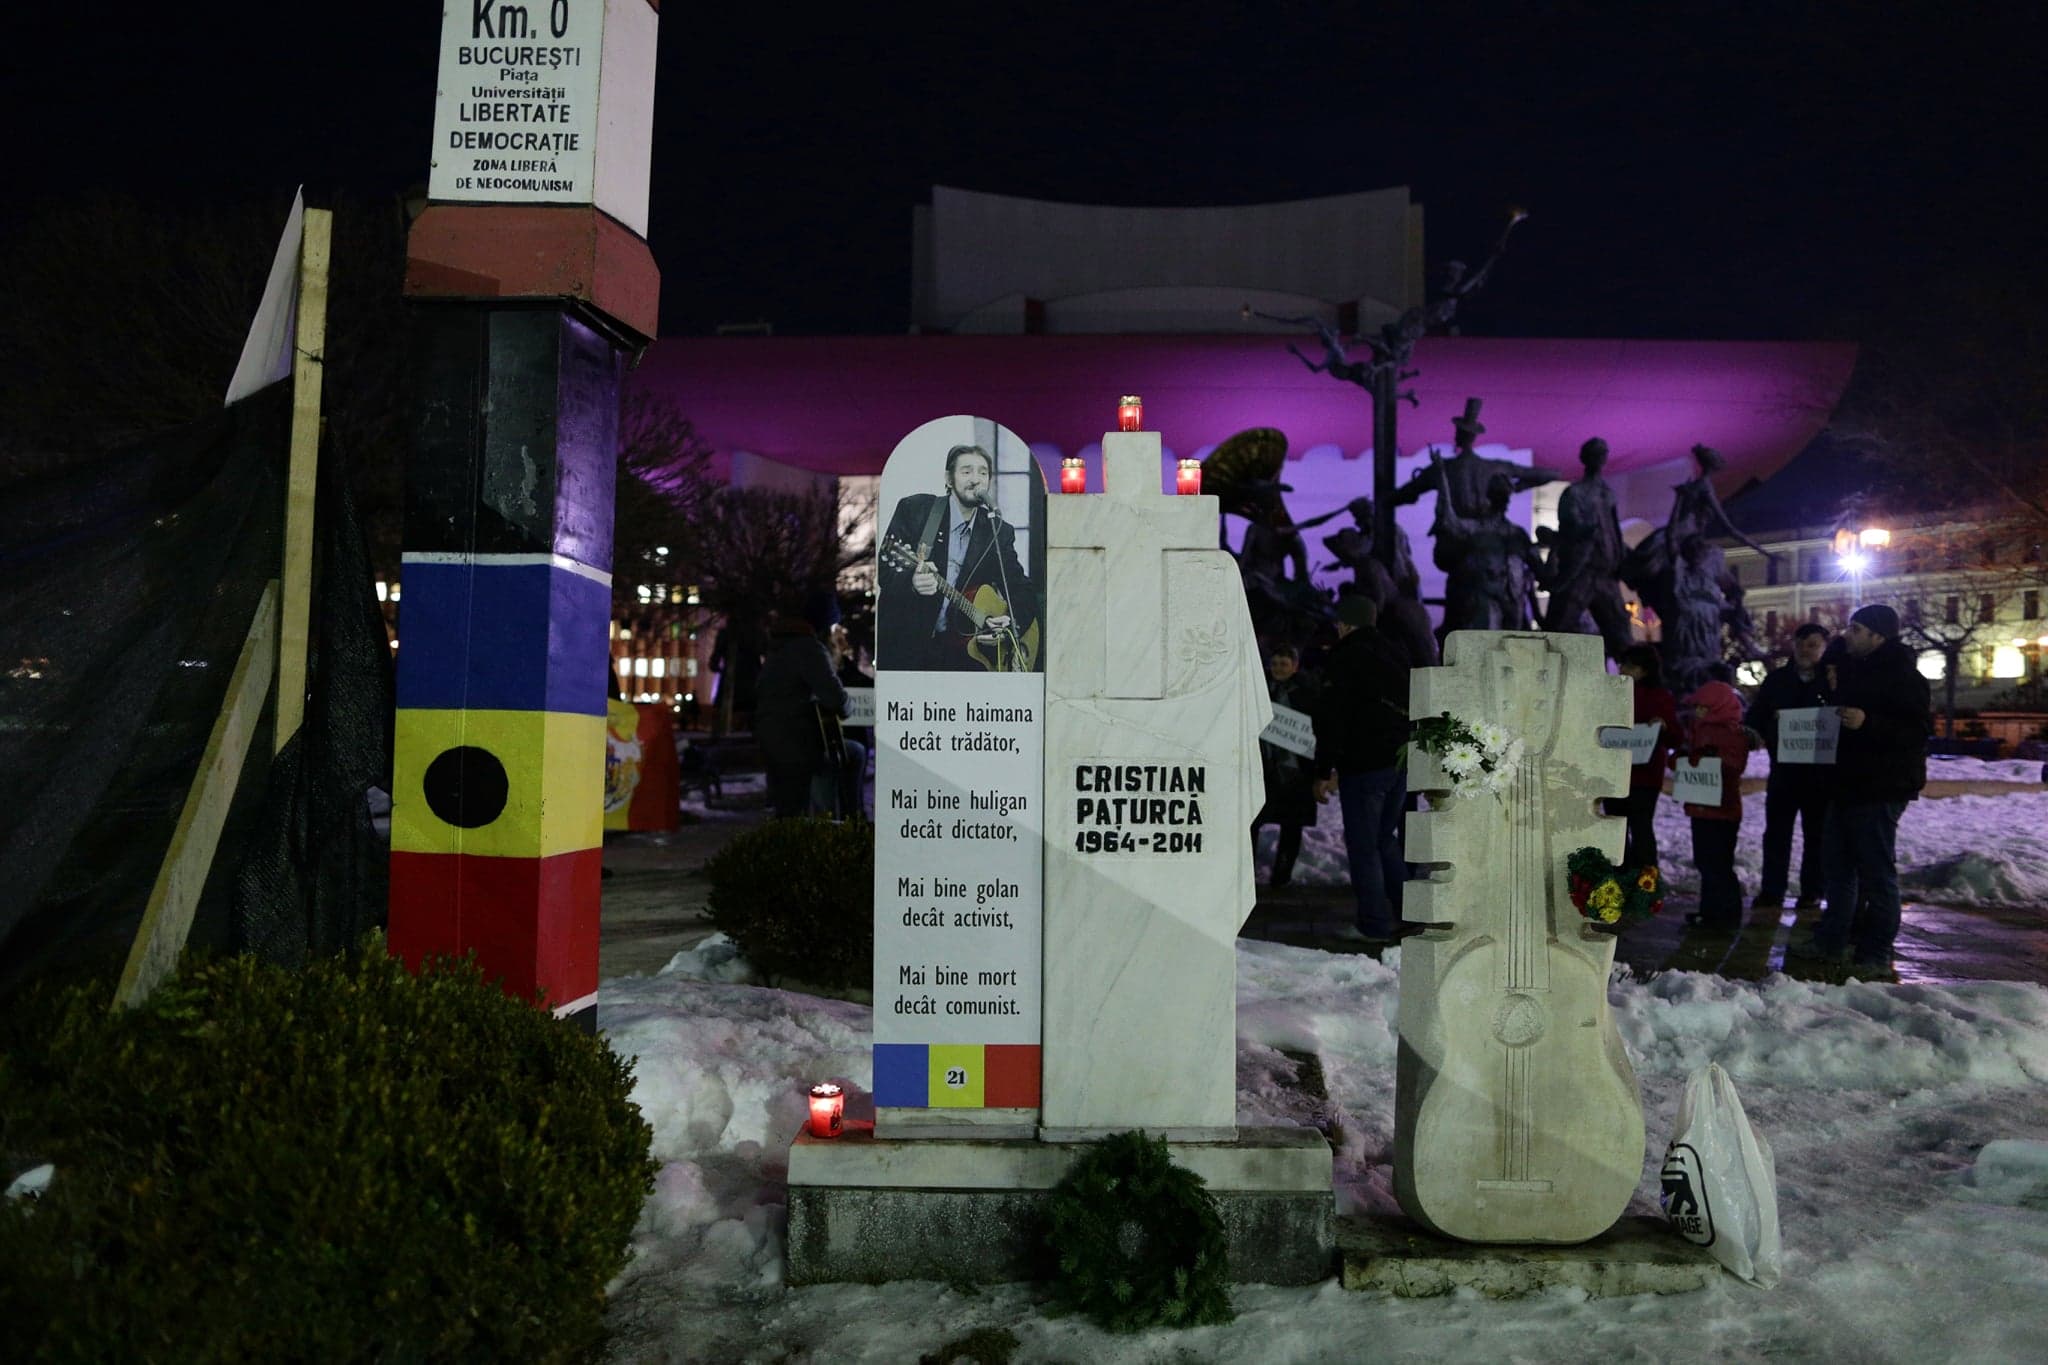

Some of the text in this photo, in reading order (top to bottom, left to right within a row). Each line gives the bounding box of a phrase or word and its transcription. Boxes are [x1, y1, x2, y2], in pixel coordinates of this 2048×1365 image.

[472, 0, 568, 39] Km. 0
[500, 69, 538, 84] Piața
[472, 87, 565, 103] Universității
[460, 103, 570, 123] LIBERTATE
[450, 132, 579, 155] DEMOCRAȚIE
[473, 159, 507, 171] ZONA
[456, 178, 573, 192] DE NEOCOMUNISM
[888, 701, 913, 721] Mai
[924, 701, 956, 721] bine
[967, 702, 1033, 722] haimana
[900, 731, 1020, 754] decât trădător,
[1076, 765, 1205, 793] CRISTIAN
[892, 789, 1027, 816] Mai bine huligan
[900, 819, 1017, 842] decât dictator,
[1076, 831, 1202, 853] 1964-2011
[898, 877, 1018, 904] Mai bine golan
[903, 907, 1013, 930] decât activist,
[899, 965, 1016, 986] Mai bine mort
[895, 995, 1020, 1015] decât comunist.
[947, 1070, 965, 1084] 21
